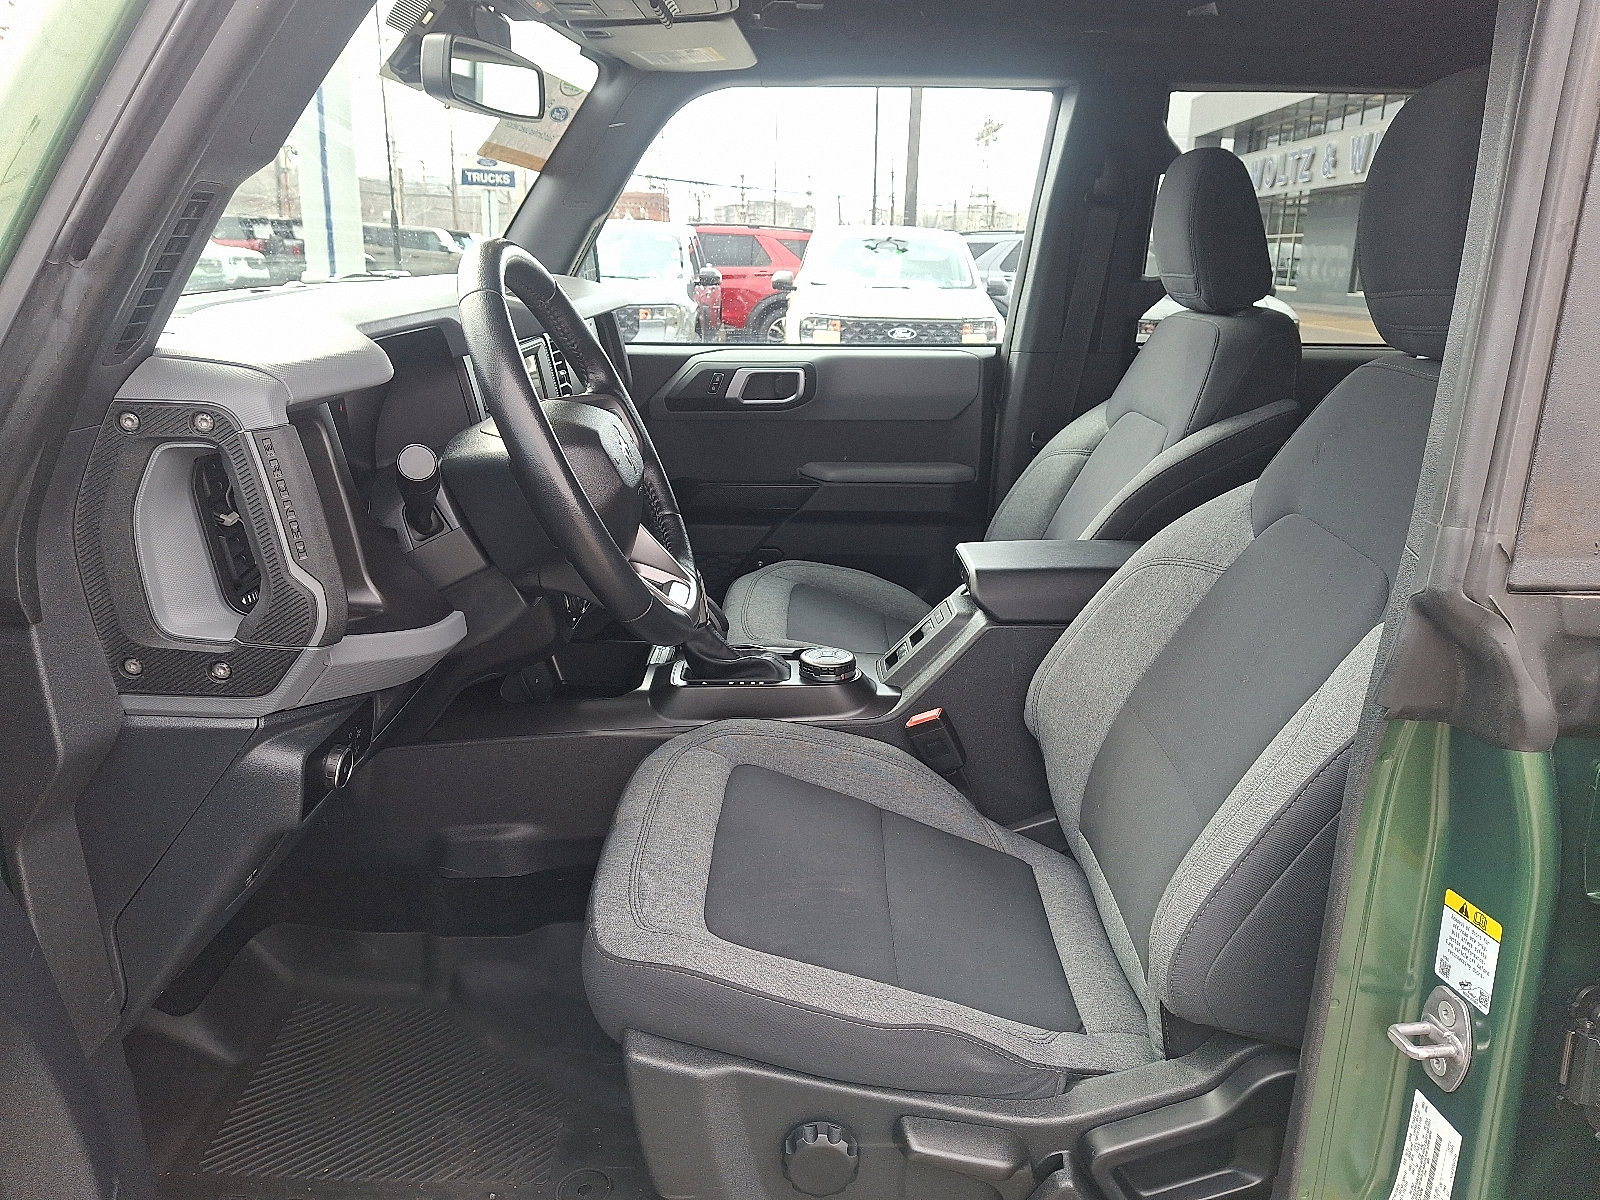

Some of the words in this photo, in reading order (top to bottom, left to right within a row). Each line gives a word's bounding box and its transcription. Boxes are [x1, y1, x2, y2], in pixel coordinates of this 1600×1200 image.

[464, 170, 511, 185] TRUCKS
[1322, 142, 1338, 179] &
[261, 437, 308, 561] BRONCO
